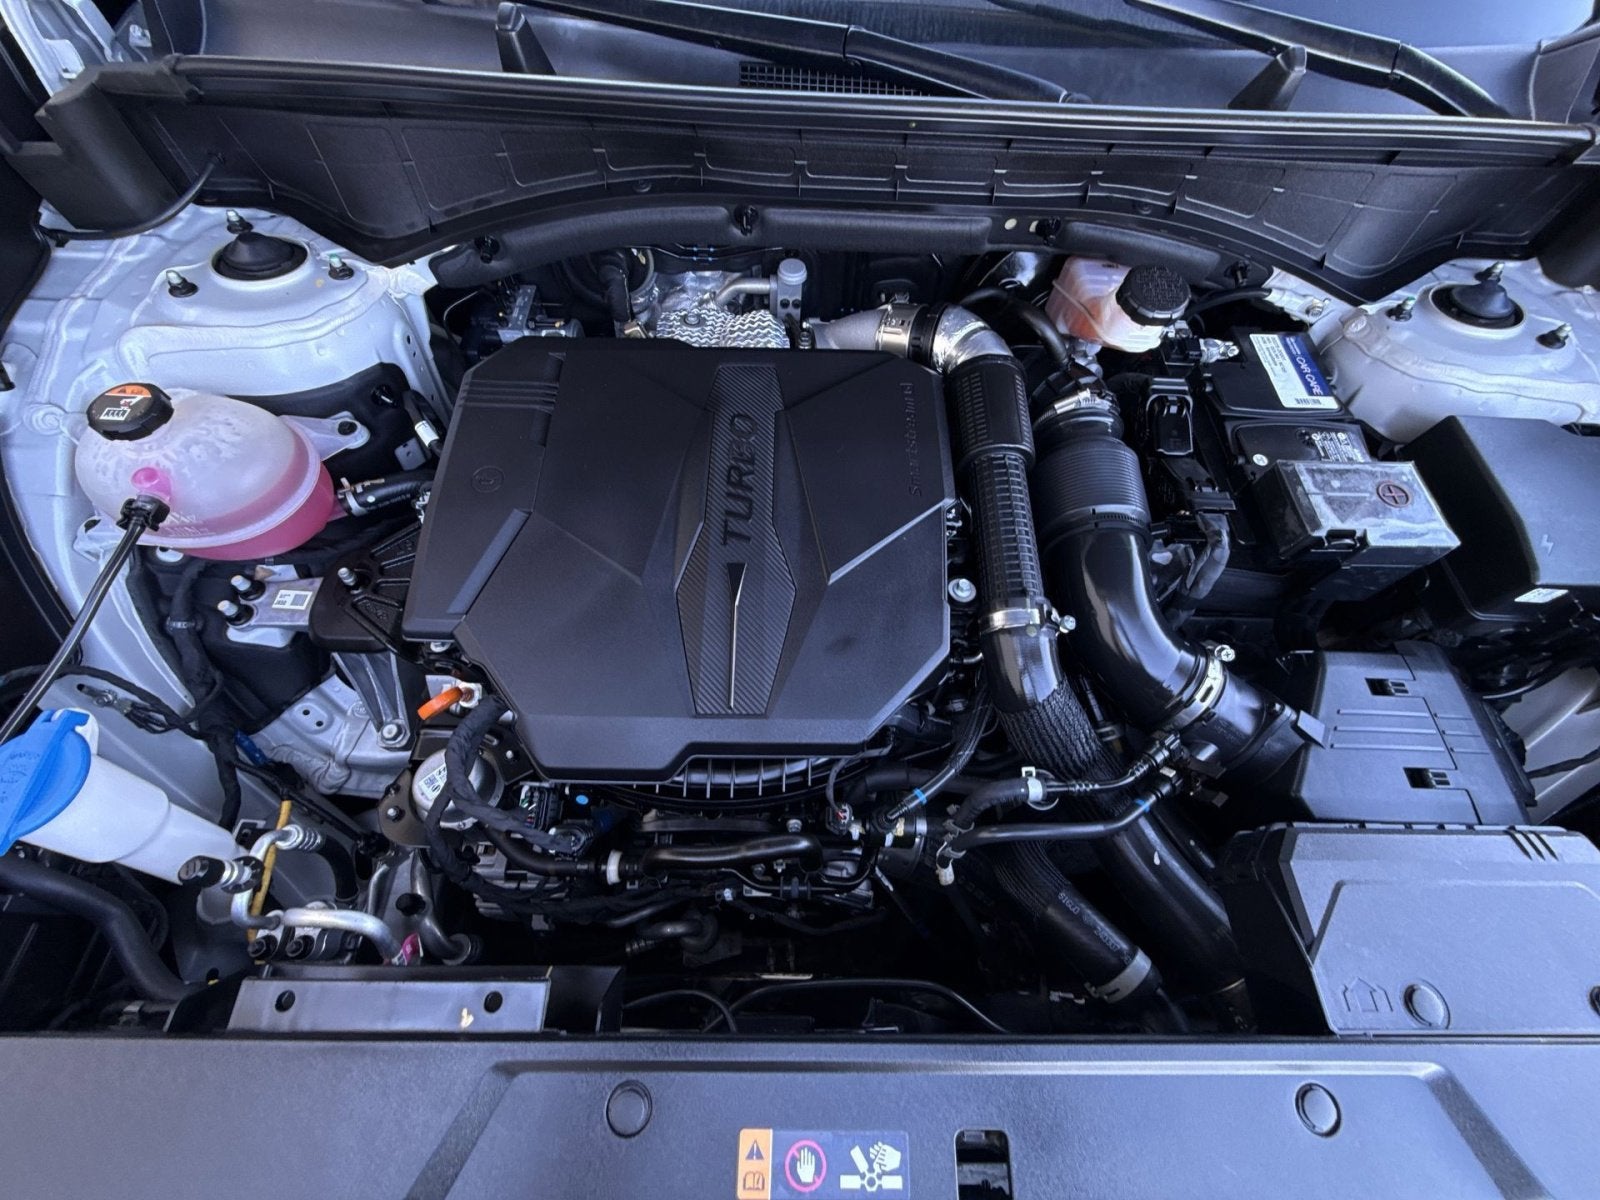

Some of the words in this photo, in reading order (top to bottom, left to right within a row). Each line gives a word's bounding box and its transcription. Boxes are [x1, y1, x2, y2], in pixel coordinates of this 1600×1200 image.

[1296, 356, 1312, 374] CAR
[1305, 374, 1324, 396] CARE
[722, 412, 757, 546] TURBO
